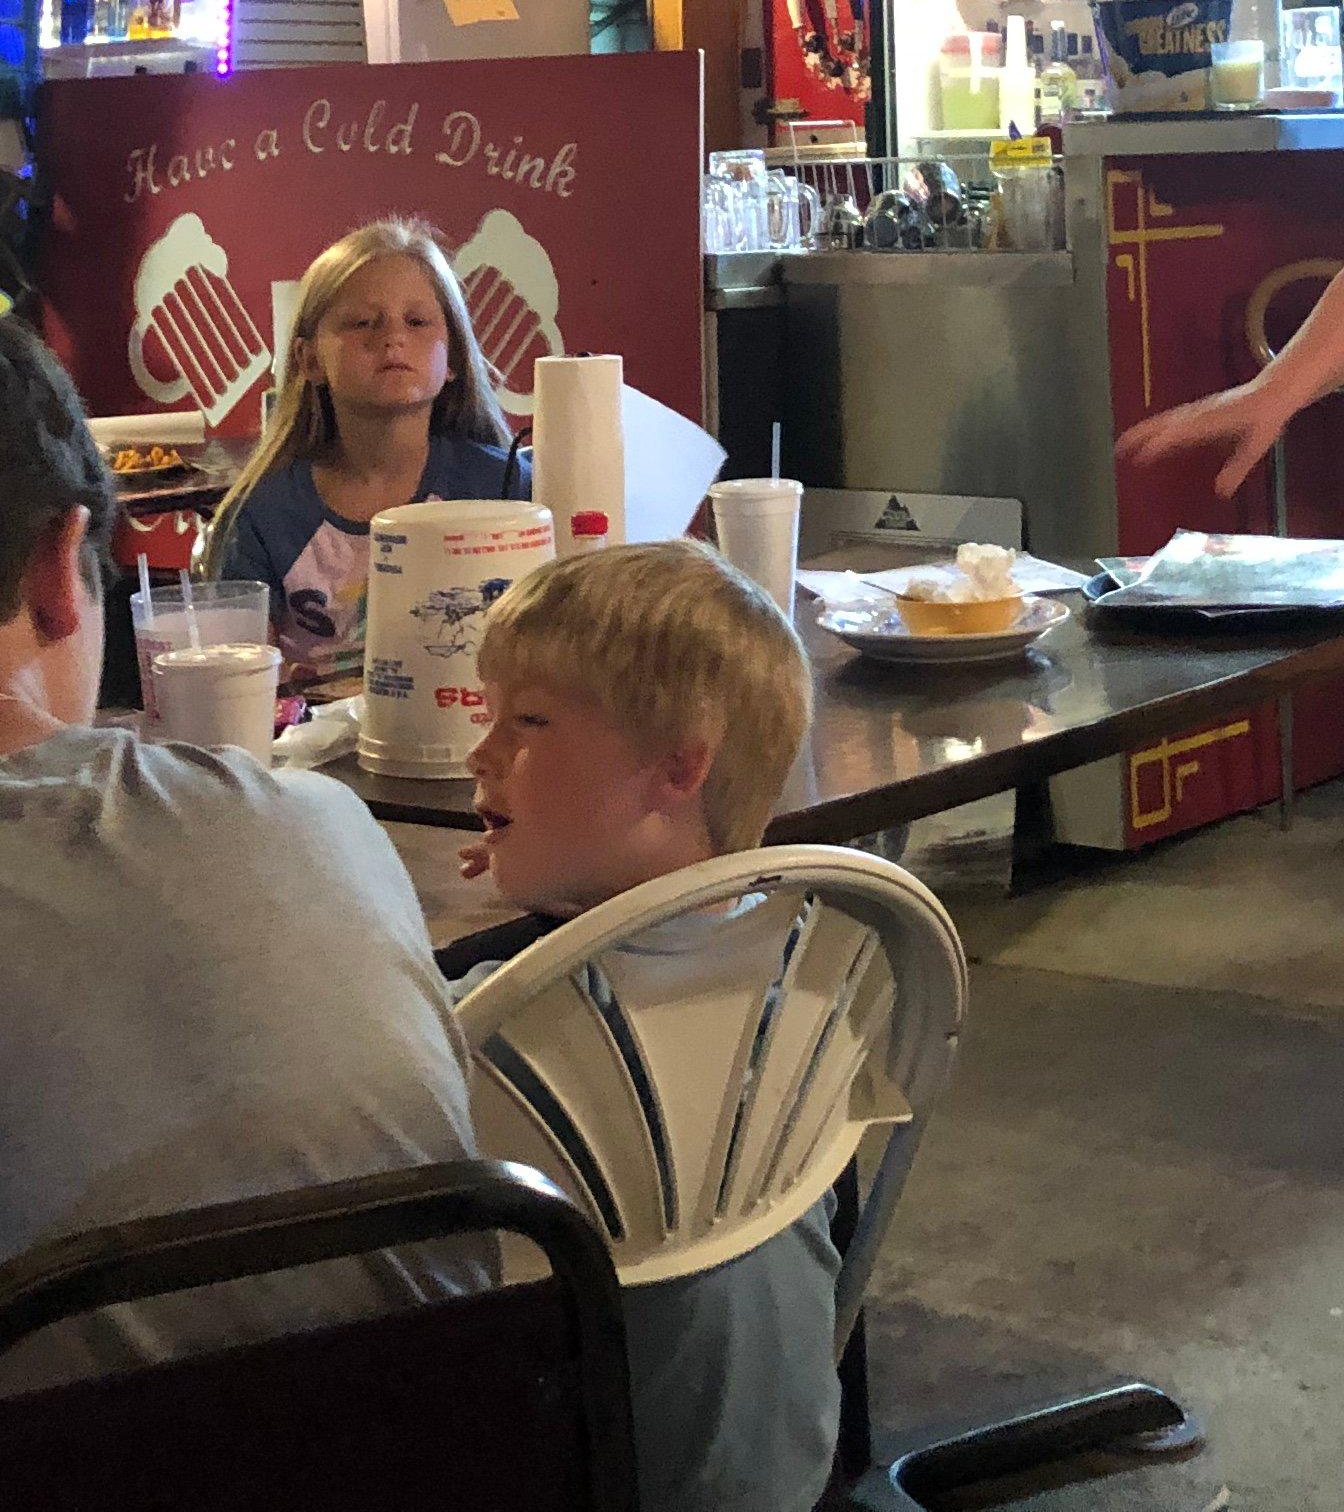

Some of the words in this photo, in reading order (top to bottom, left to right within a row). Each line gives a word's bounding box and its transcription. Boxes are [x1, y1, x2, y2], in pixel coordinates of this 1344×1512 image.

[123, 135, 236, 203] Have
[253, 128, 281, 160] a
[301, 98, 420, 155] Cold
[434, 108, 579, 198] Drink
